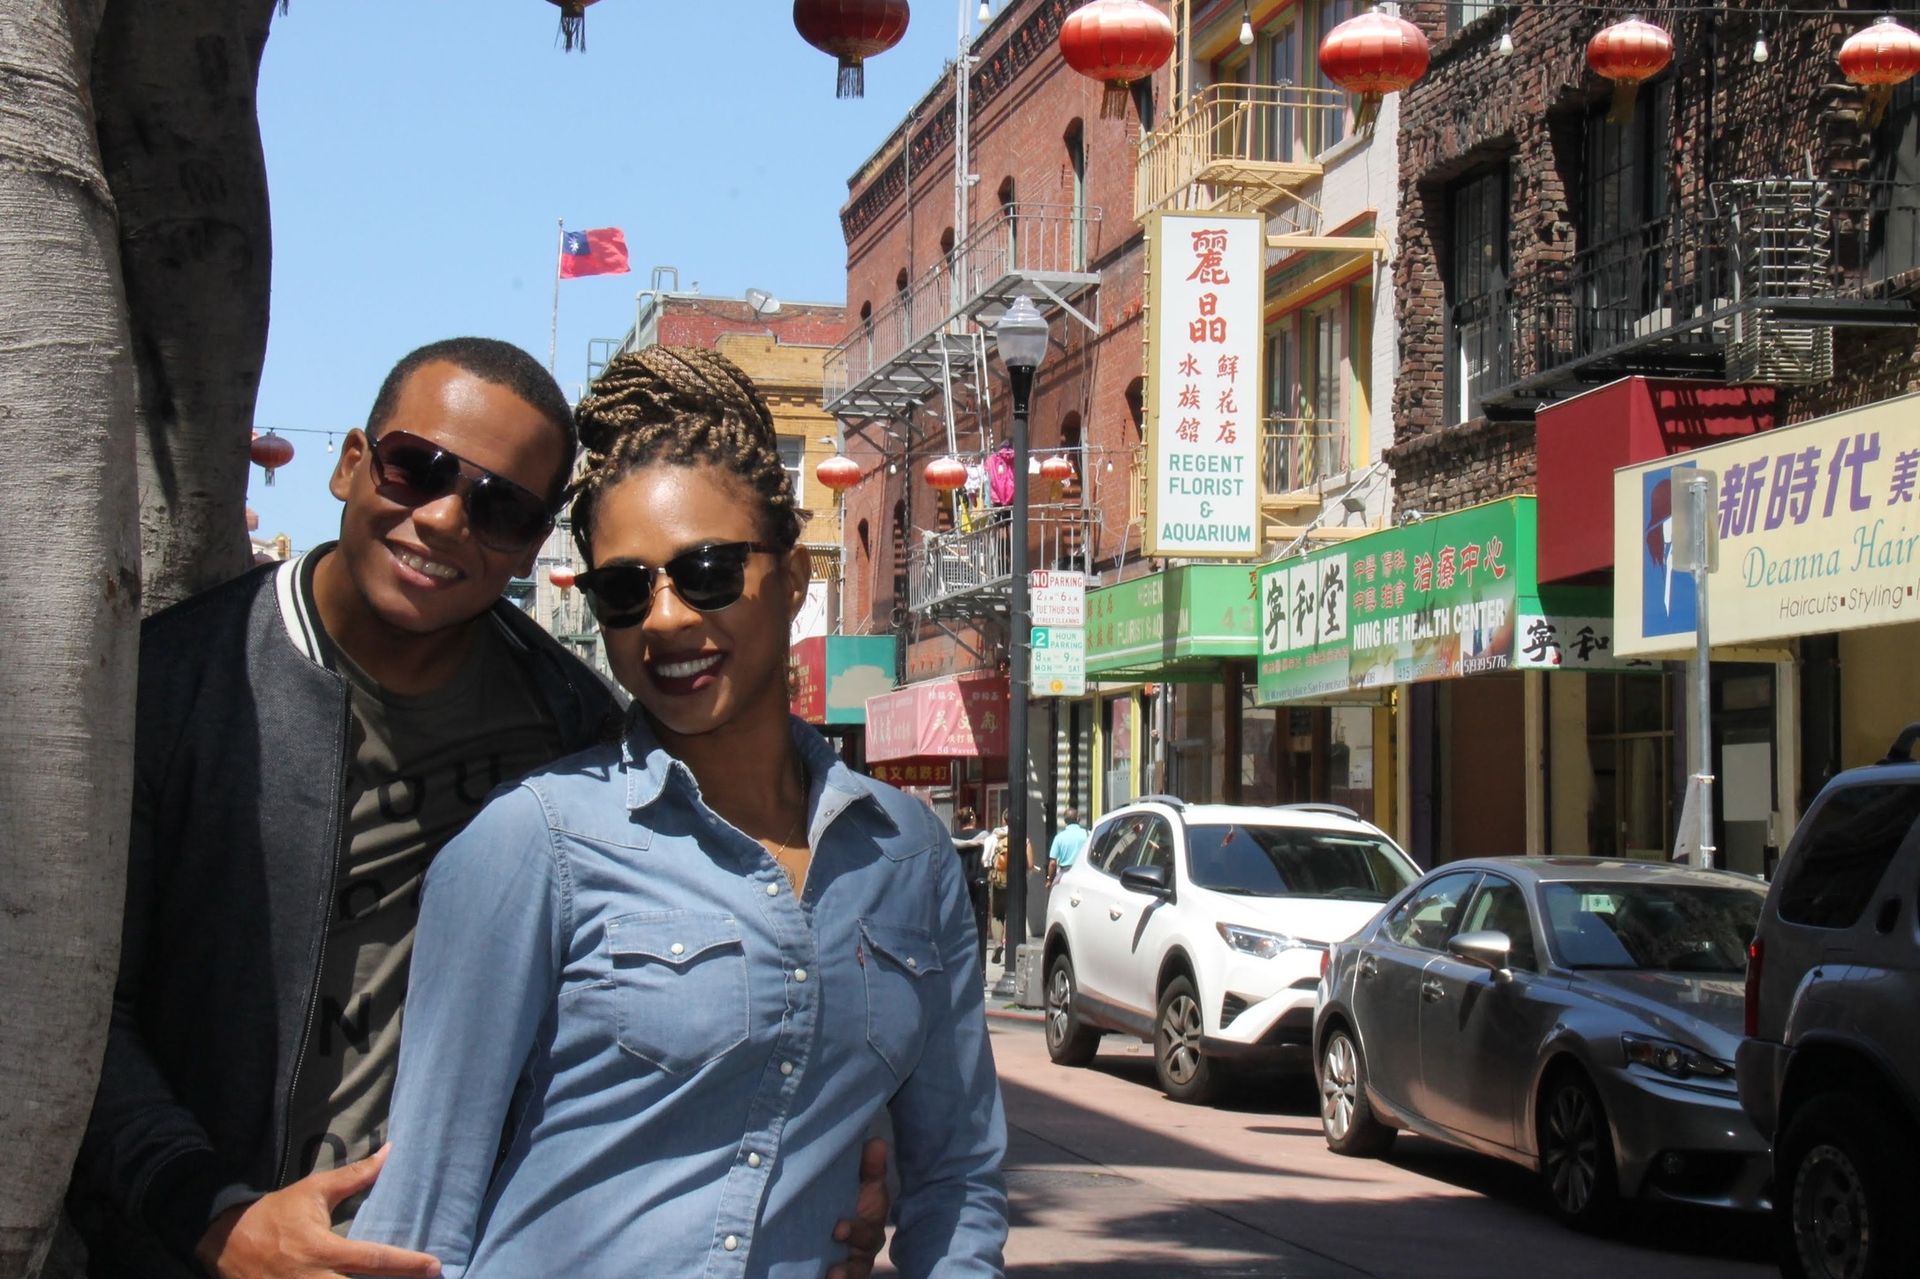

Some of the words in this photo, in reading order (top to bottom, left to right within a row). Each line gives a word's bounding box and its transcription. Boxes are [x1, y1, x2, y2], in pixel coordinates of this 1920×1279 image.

[1186, 229, 1230, 344] 麗晶
[1215, 354, 1240, 444] 鮮花店
[1169, 454, 1244, 473] REGENT
[1169, 477, 1244, 495] FLORIST
[1717, 432, 1881, 539] 新時代
[1200, 501, 1215, 518] &
[1162, 523, 1251, 543] AQUARIUM
[1742, 546, 1841, 588] Deanna
[1850, 519, 1920, 572] Hair
[1413, 535, 1506, 593] 治療中心
[1033, 572, 1047, 587] NO
[1050, 576, 1083, 588] PARKING
[1036, 605, 1047, 614] TUE
[1048, 605, 1066, 615] THUR
[1067, 606, 1080, 615] SUN
[1779, 591, 1838, 619] Haircuts
[1848, 584, 1904, 611] Styling
[1353, 621, 1381, 650] NING
[1383, 616, 1400, 643] HE
[1402, 608, 1450, 641] HEALTH
[1452, 599, 1506, 632] CENTER
[1035, 632, 1046, 647] 2
[1055, 632, 1077, 640] HOUR
[1050, 641, 1083, 649] PARKING
[1034, 664, 1053, 672] MON
